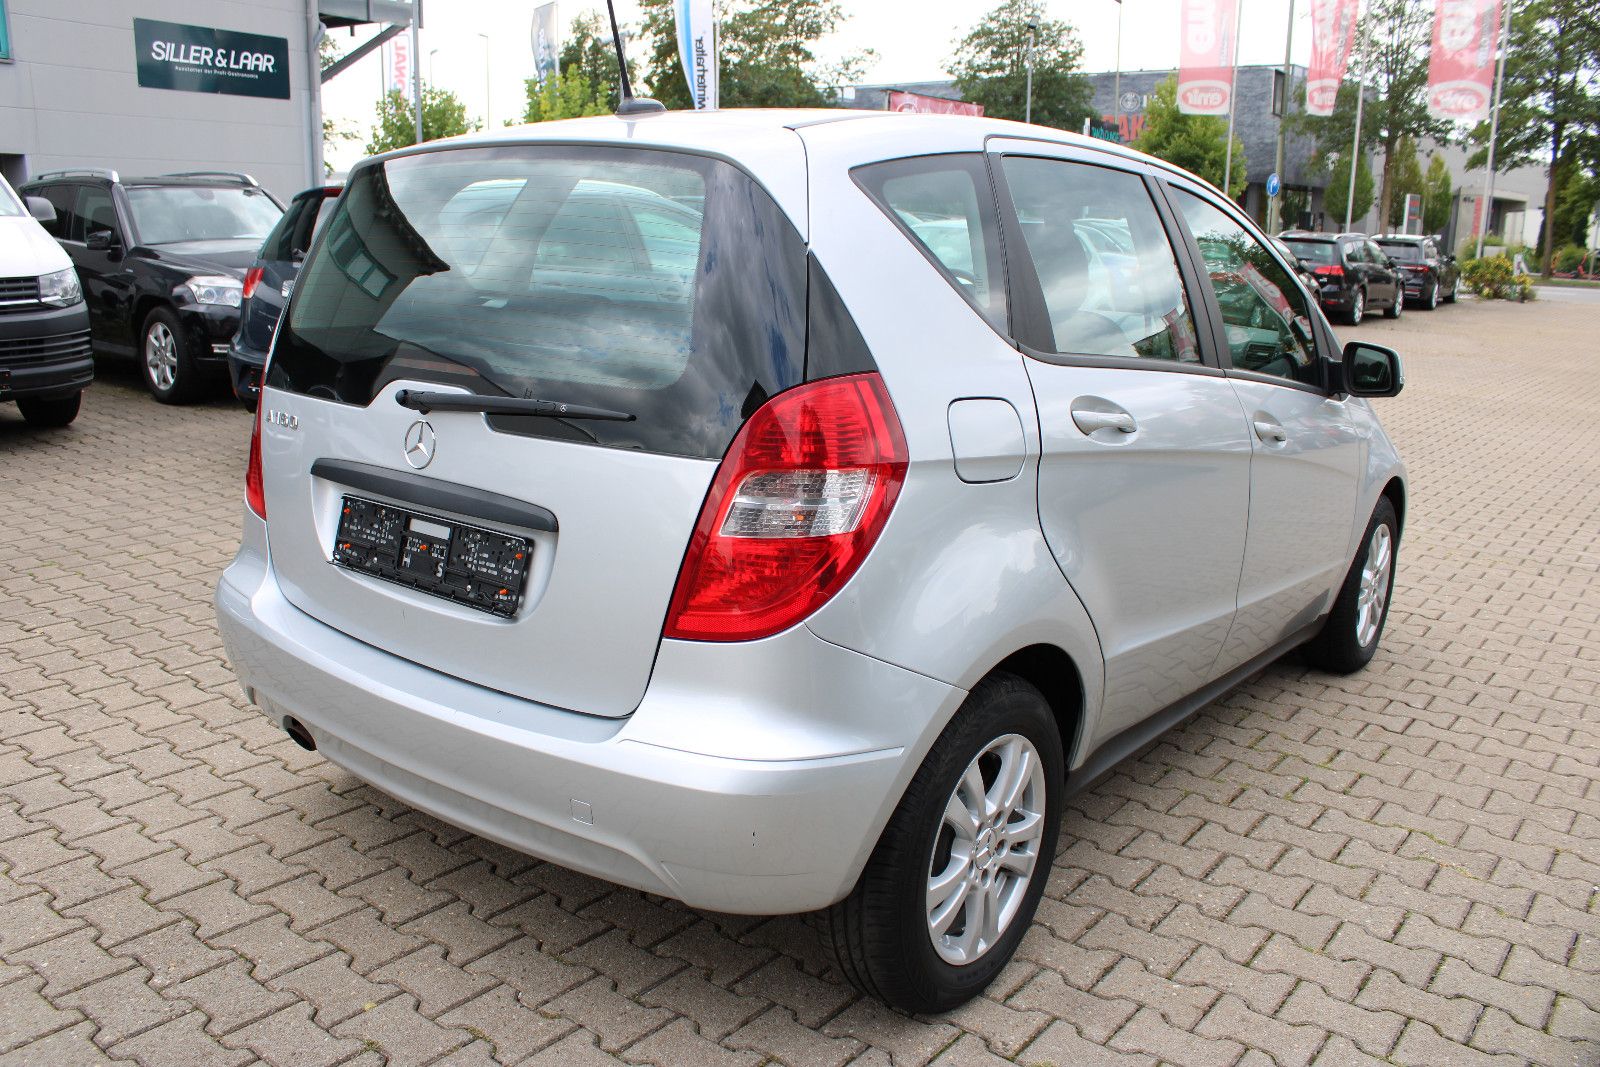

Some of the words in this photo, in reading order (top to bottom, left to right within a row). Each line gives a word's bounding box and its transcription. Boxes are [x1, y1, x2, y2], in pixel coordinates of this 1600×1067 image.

[151, 40, 213, 66] SILLER
[215, 48, 228, 68] &
[229, 50, 275, 73] LAAR
